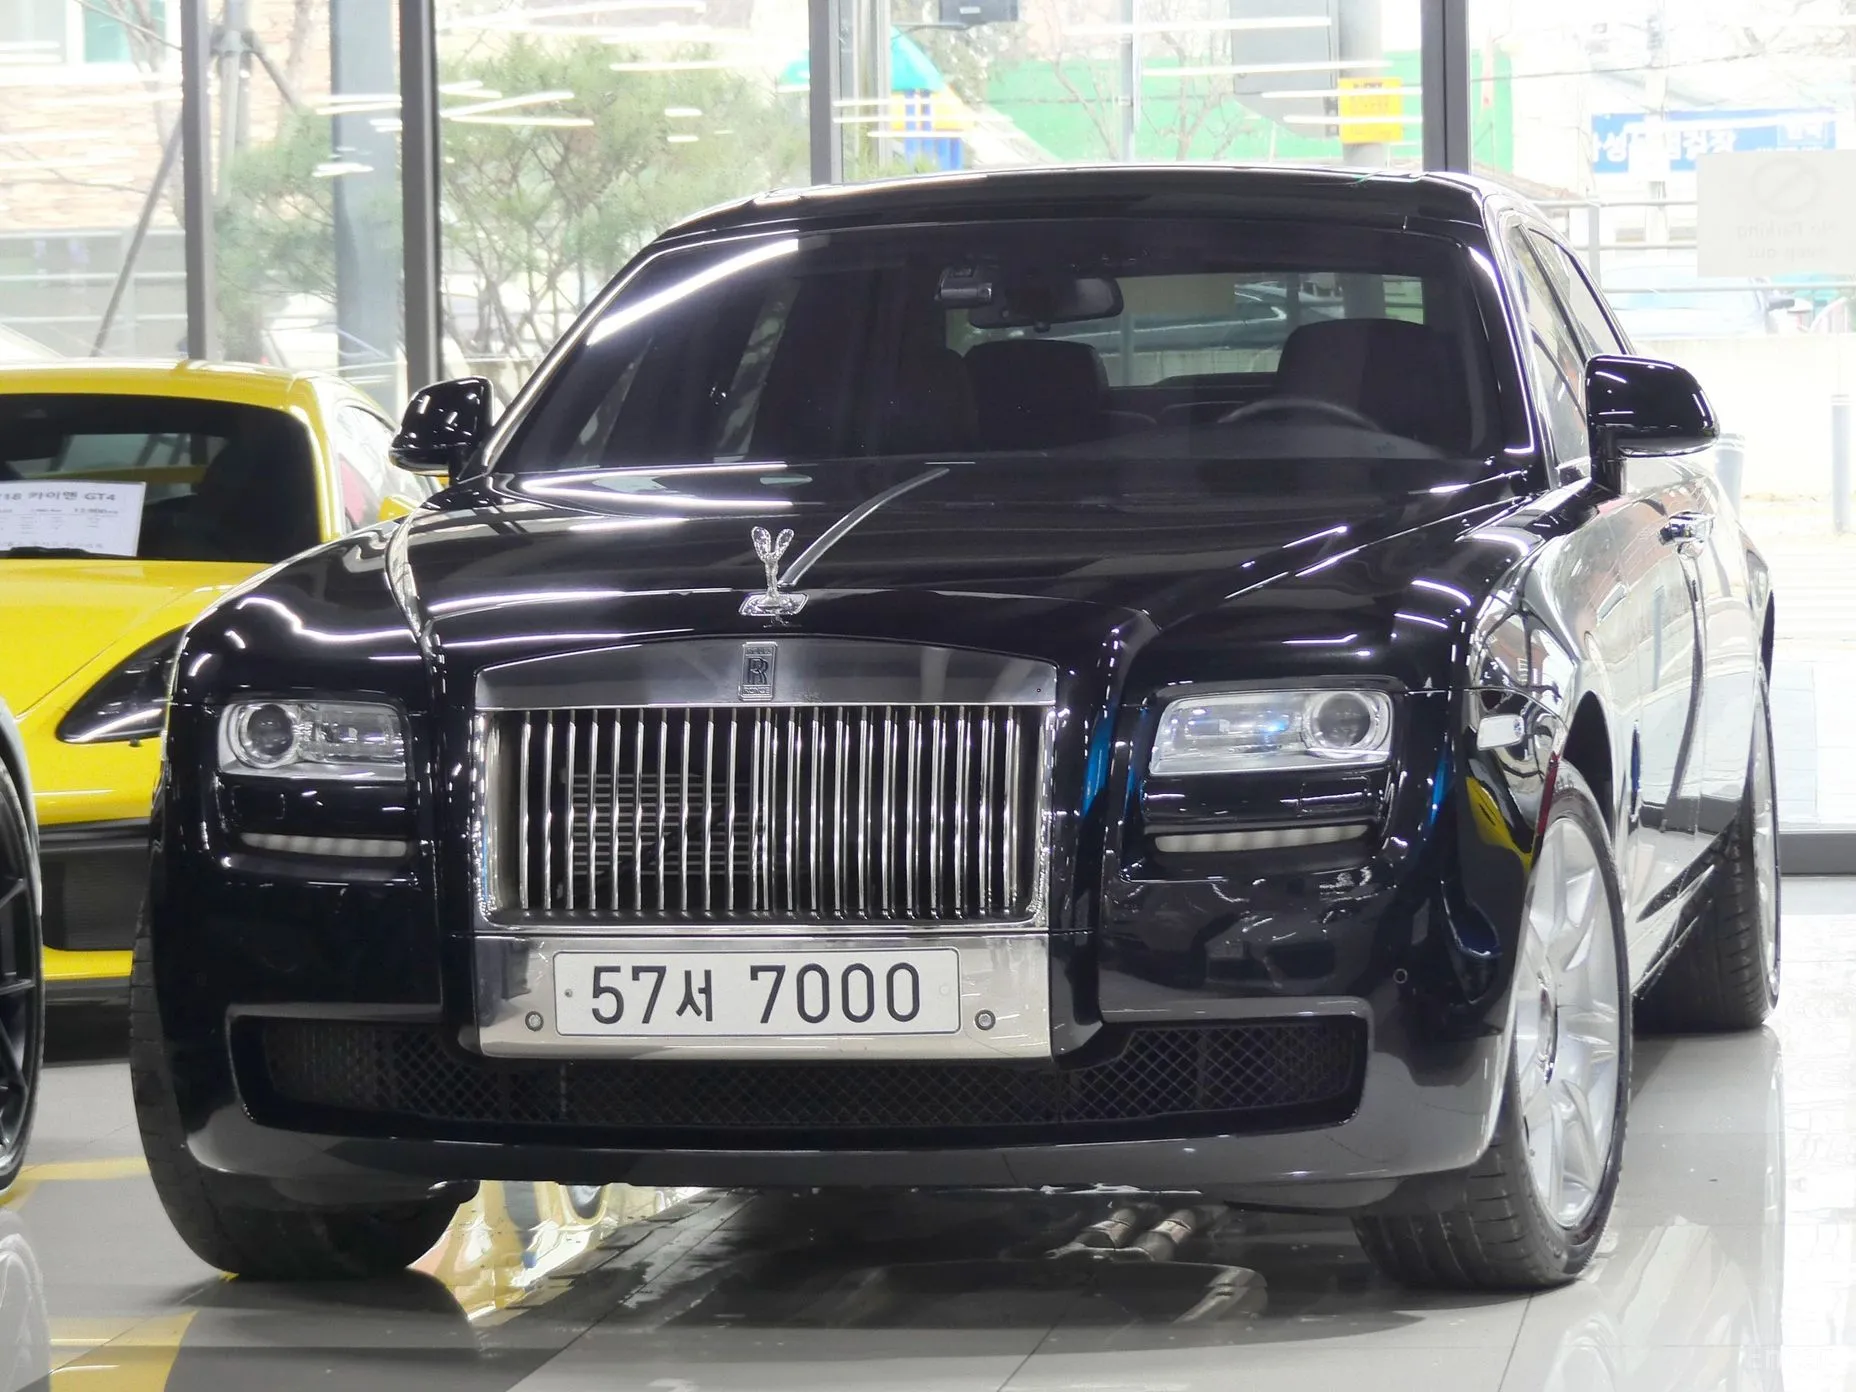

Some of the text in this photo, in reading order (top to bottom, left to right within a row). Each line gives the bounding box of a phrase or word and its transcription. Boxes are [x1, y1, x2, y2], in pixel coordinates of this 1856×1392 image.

[0, 492, 22, 501] 18
[84, 492, 116, 501] GT4
[591, 962, 921, 1025] 57서 7000
